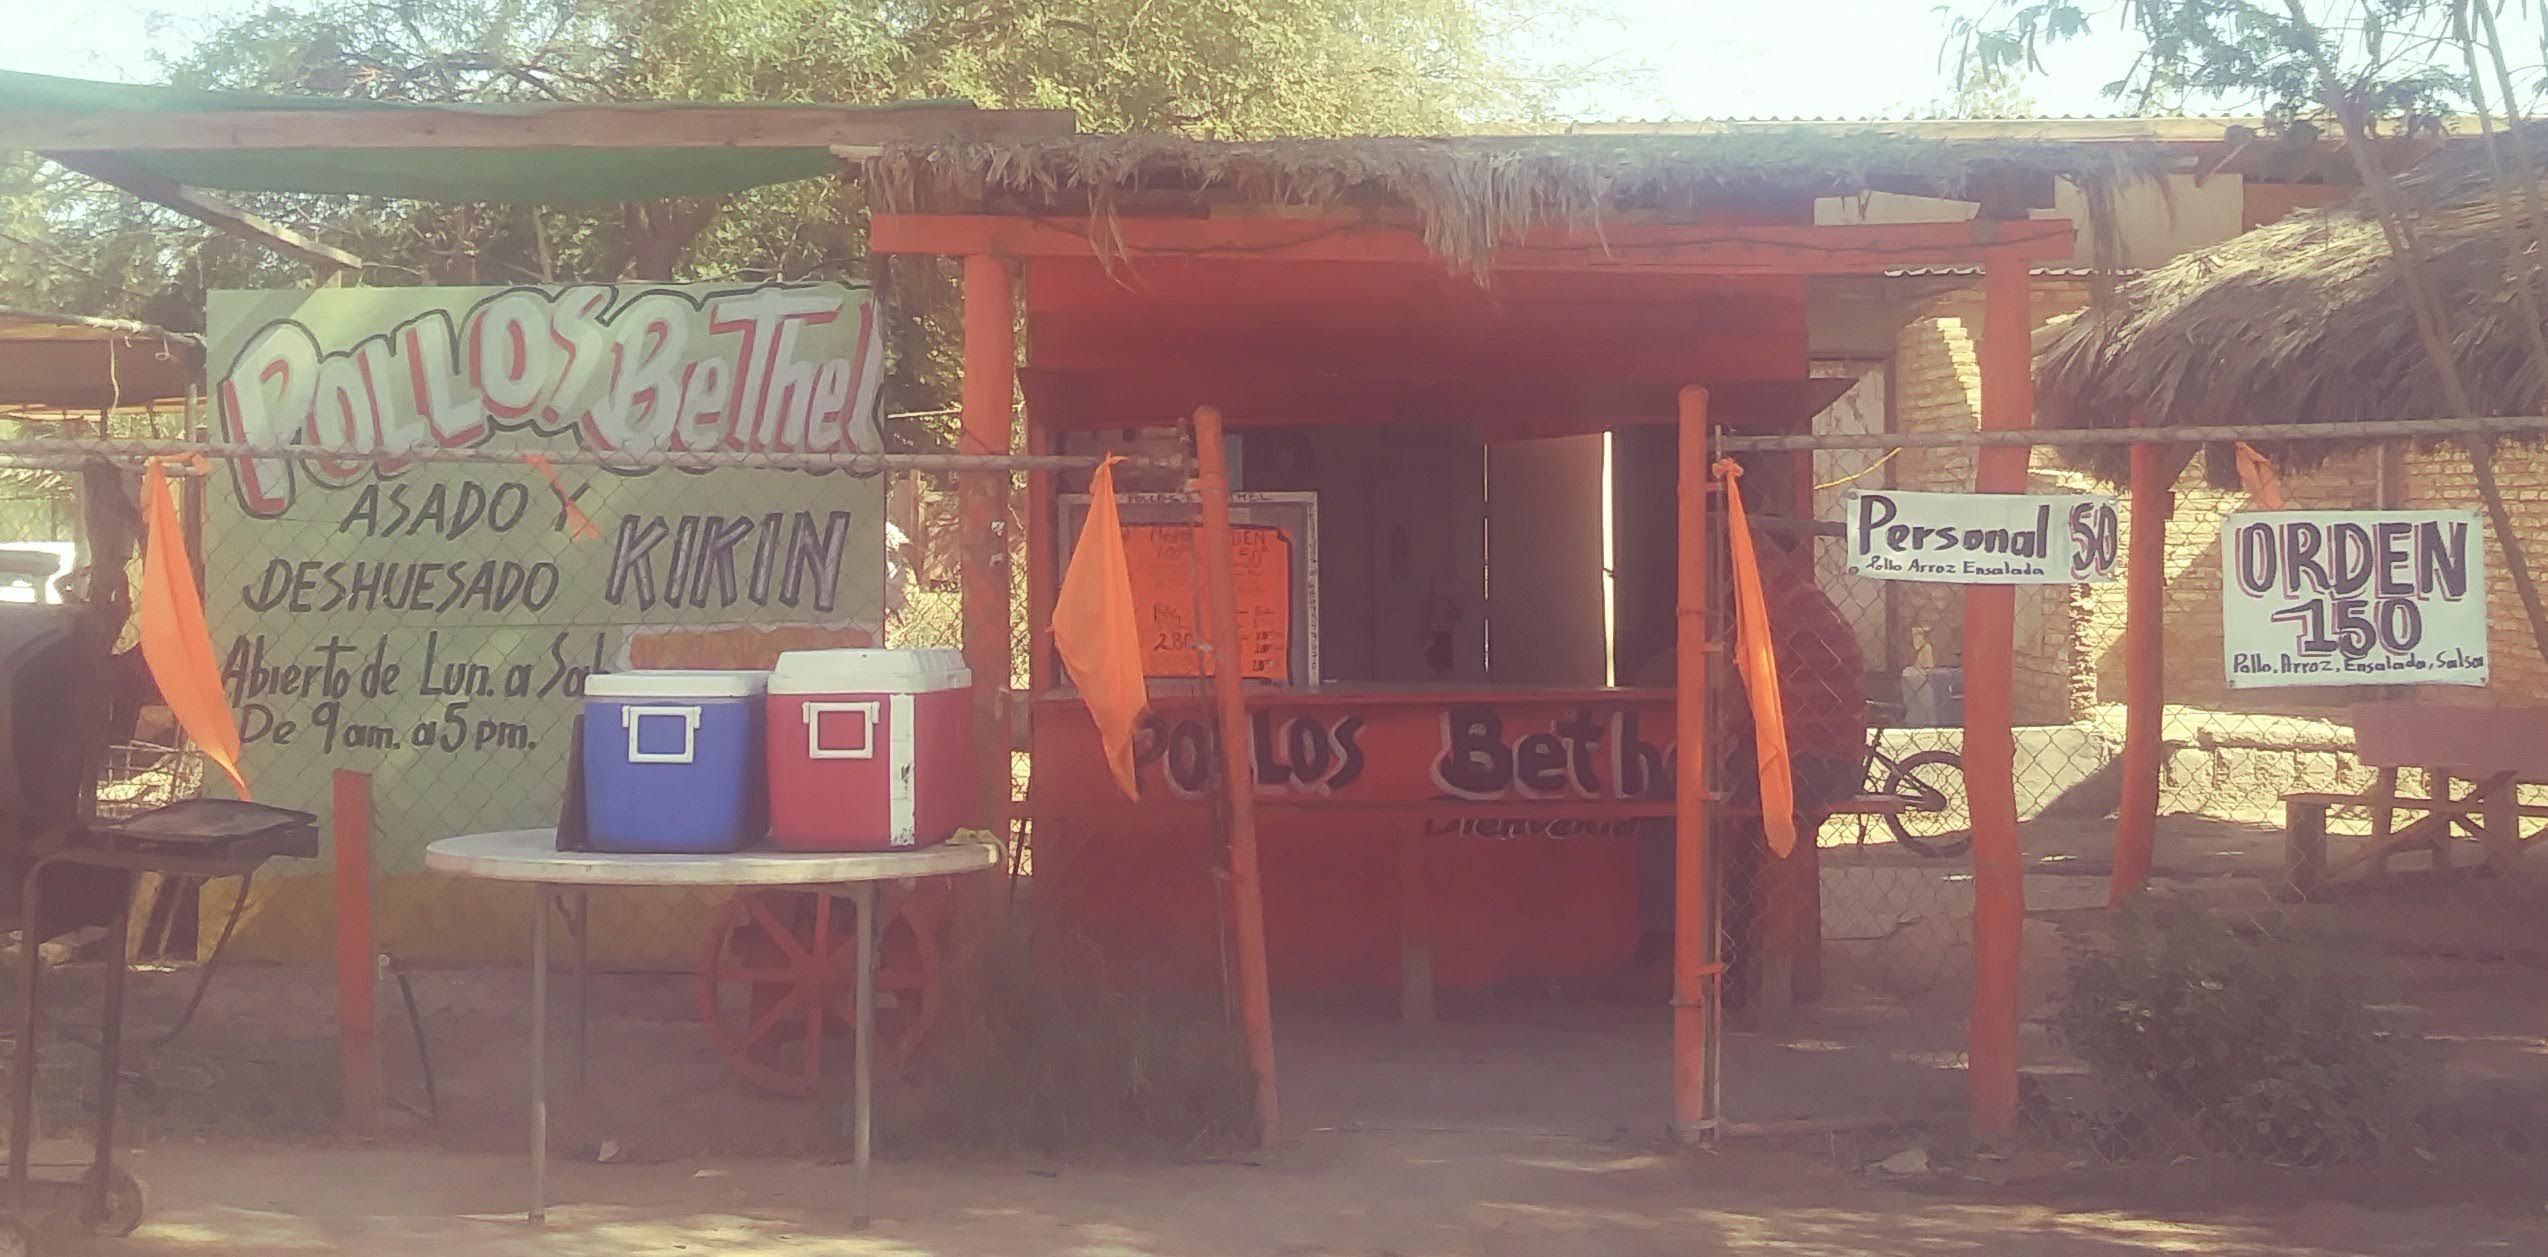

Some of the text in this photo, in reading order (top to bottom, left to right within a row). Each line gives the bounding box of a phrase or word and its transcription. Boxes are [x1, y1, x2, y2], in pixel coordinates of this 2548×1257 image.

[338, 482, 591, 541] ASADO Y
[1858, 494, 2118, 580] Personal 50
[242, 558, 559, 613] DESHUESADO
[605, 510, 851, 612] KIKIN
[1866, 555, 2045, 576] Pollo Arroz Ensalada
[2234, 520, 2468, 602] ORDEN
[2270, 599, 2423, 660] 150
[2436, 647, 2484, 669] Salsa
[221, 635, 356, 708] Abierto
[361, 635, 401, 698] de
[420, 630, 493, 697] Lun.
[508, 662, 538, 698] a
[239, 703, 297, 745] De
